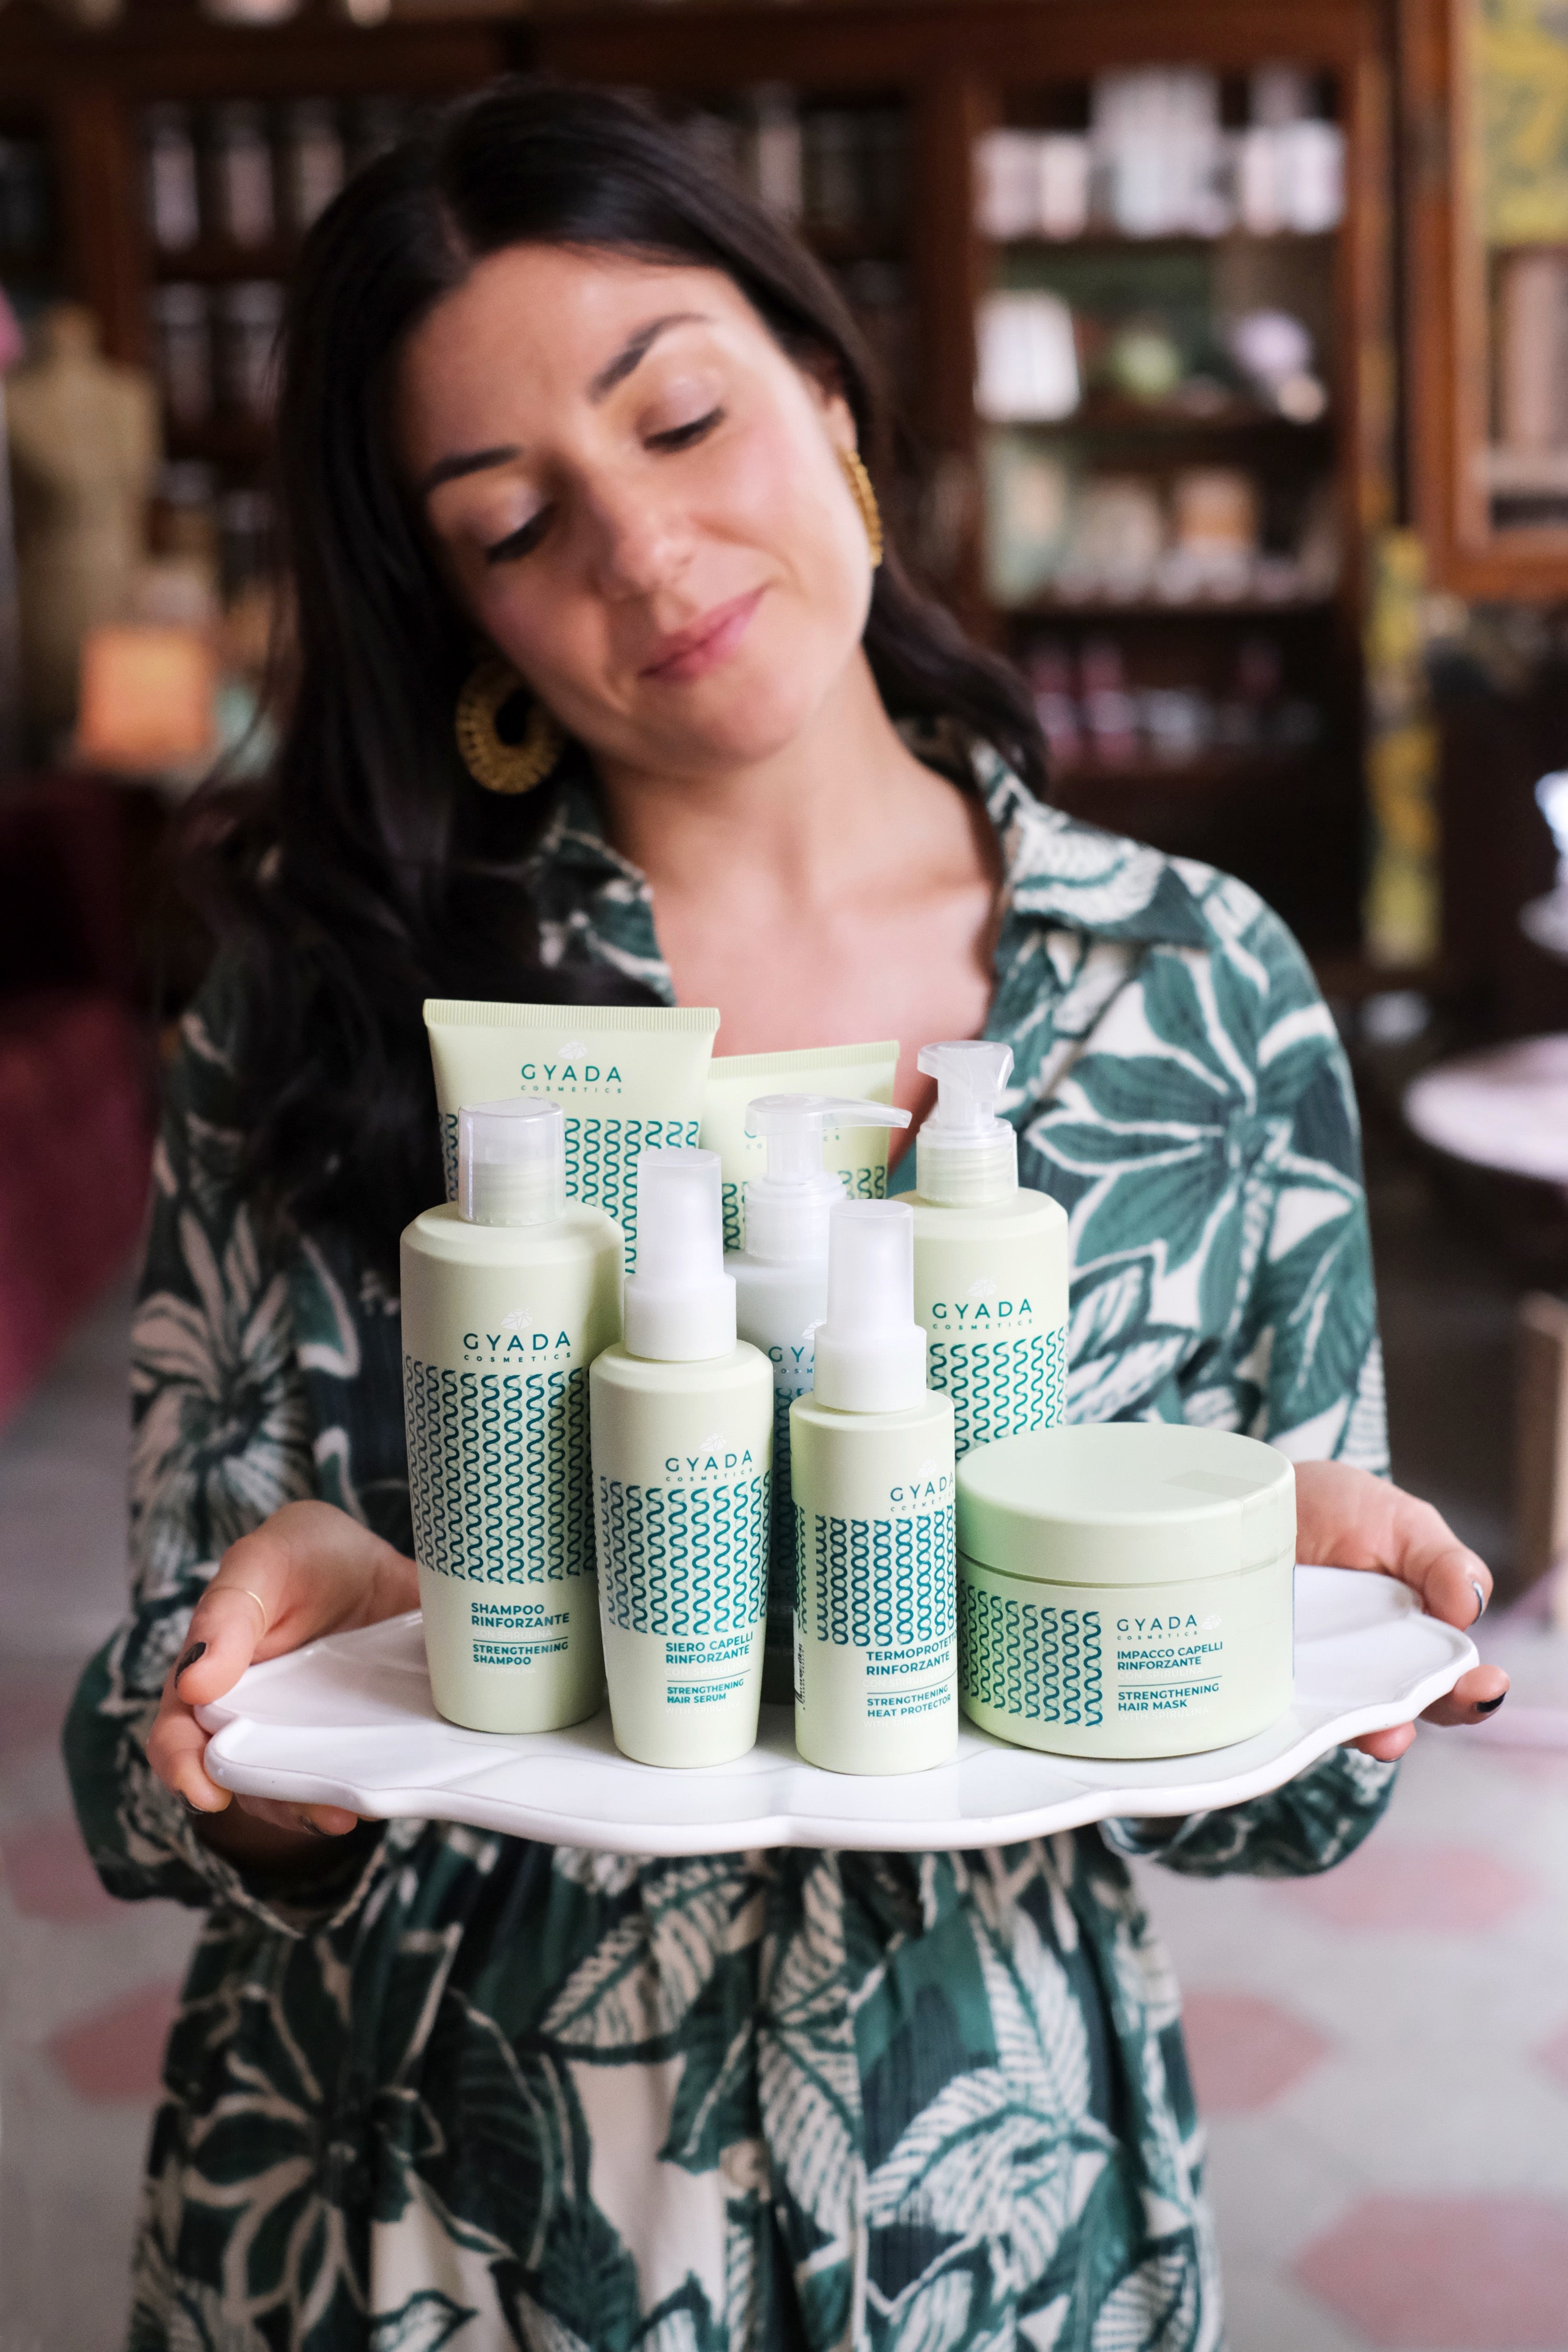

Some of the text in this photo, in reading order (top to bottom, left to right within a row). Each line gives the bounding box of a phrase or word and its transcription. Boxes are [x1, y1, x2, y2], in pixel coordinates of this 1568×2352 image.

[521, 1064, 621, 1082] GYADA
[521, 1085, 621, 1093] COSMETICS
[932, 1298, 1032, 1319] GYADA
[933, 1319, 1032, 1330] COSMETICS
[463, 1331, 571, 1351] GYADA
[464, 1352, 571, 1363] COSMETICS
[665, 1449, 752, 1472] GYADA
[666, 1468, 753, 1482] COSMETICS
[891, 1472, 953, 1502] GYADA
[471, 1602, 545, 1615] SHAMPOO
[471, 1612, 570, 1628] RINFORZANTE
[1117, 1615, 1197, 1631] GYADA
[498, 1630, 552, 1640] SPIRULINA
[666, 1642, 705, 1652] SIERO
[710, 1631, 753, 1650] CAPELLI
[1117, 1631, 1197, 1640] COSMETICS
[473, 1642, 569, 1655] STRENGTHENING
[666, 1645, 750, 1664] RINFORZANTE
[1117, 1641, 1223, 1659] IMPACCO CAPELLI
[473, 1654, 531, 1665] SHAMPOO
[867, 1651, 950, 1675] RINFORZANTE
[1117, 1656, 1202, 1670] RINFORZANTE
[664, 1659, 747, 1676] CON SPIRULINA
[1146, 1667, 1203, 1679] SPIRULINA
[667, 1679, 744, 1694] STRENGTHENING
[1118, 1683, 1219, 1700] STRENGTHENING
[694, 1693, 727, 1703] SERUM
[867, 1685, 948, 1706] STRENGTHENING
[901, 1694, 951, 1715] PROTECTOR
[1118, 1699, 1187, 1711] HAIR MASK
[1118, 1707, 1208, 1721] WITH SPIRULINA
